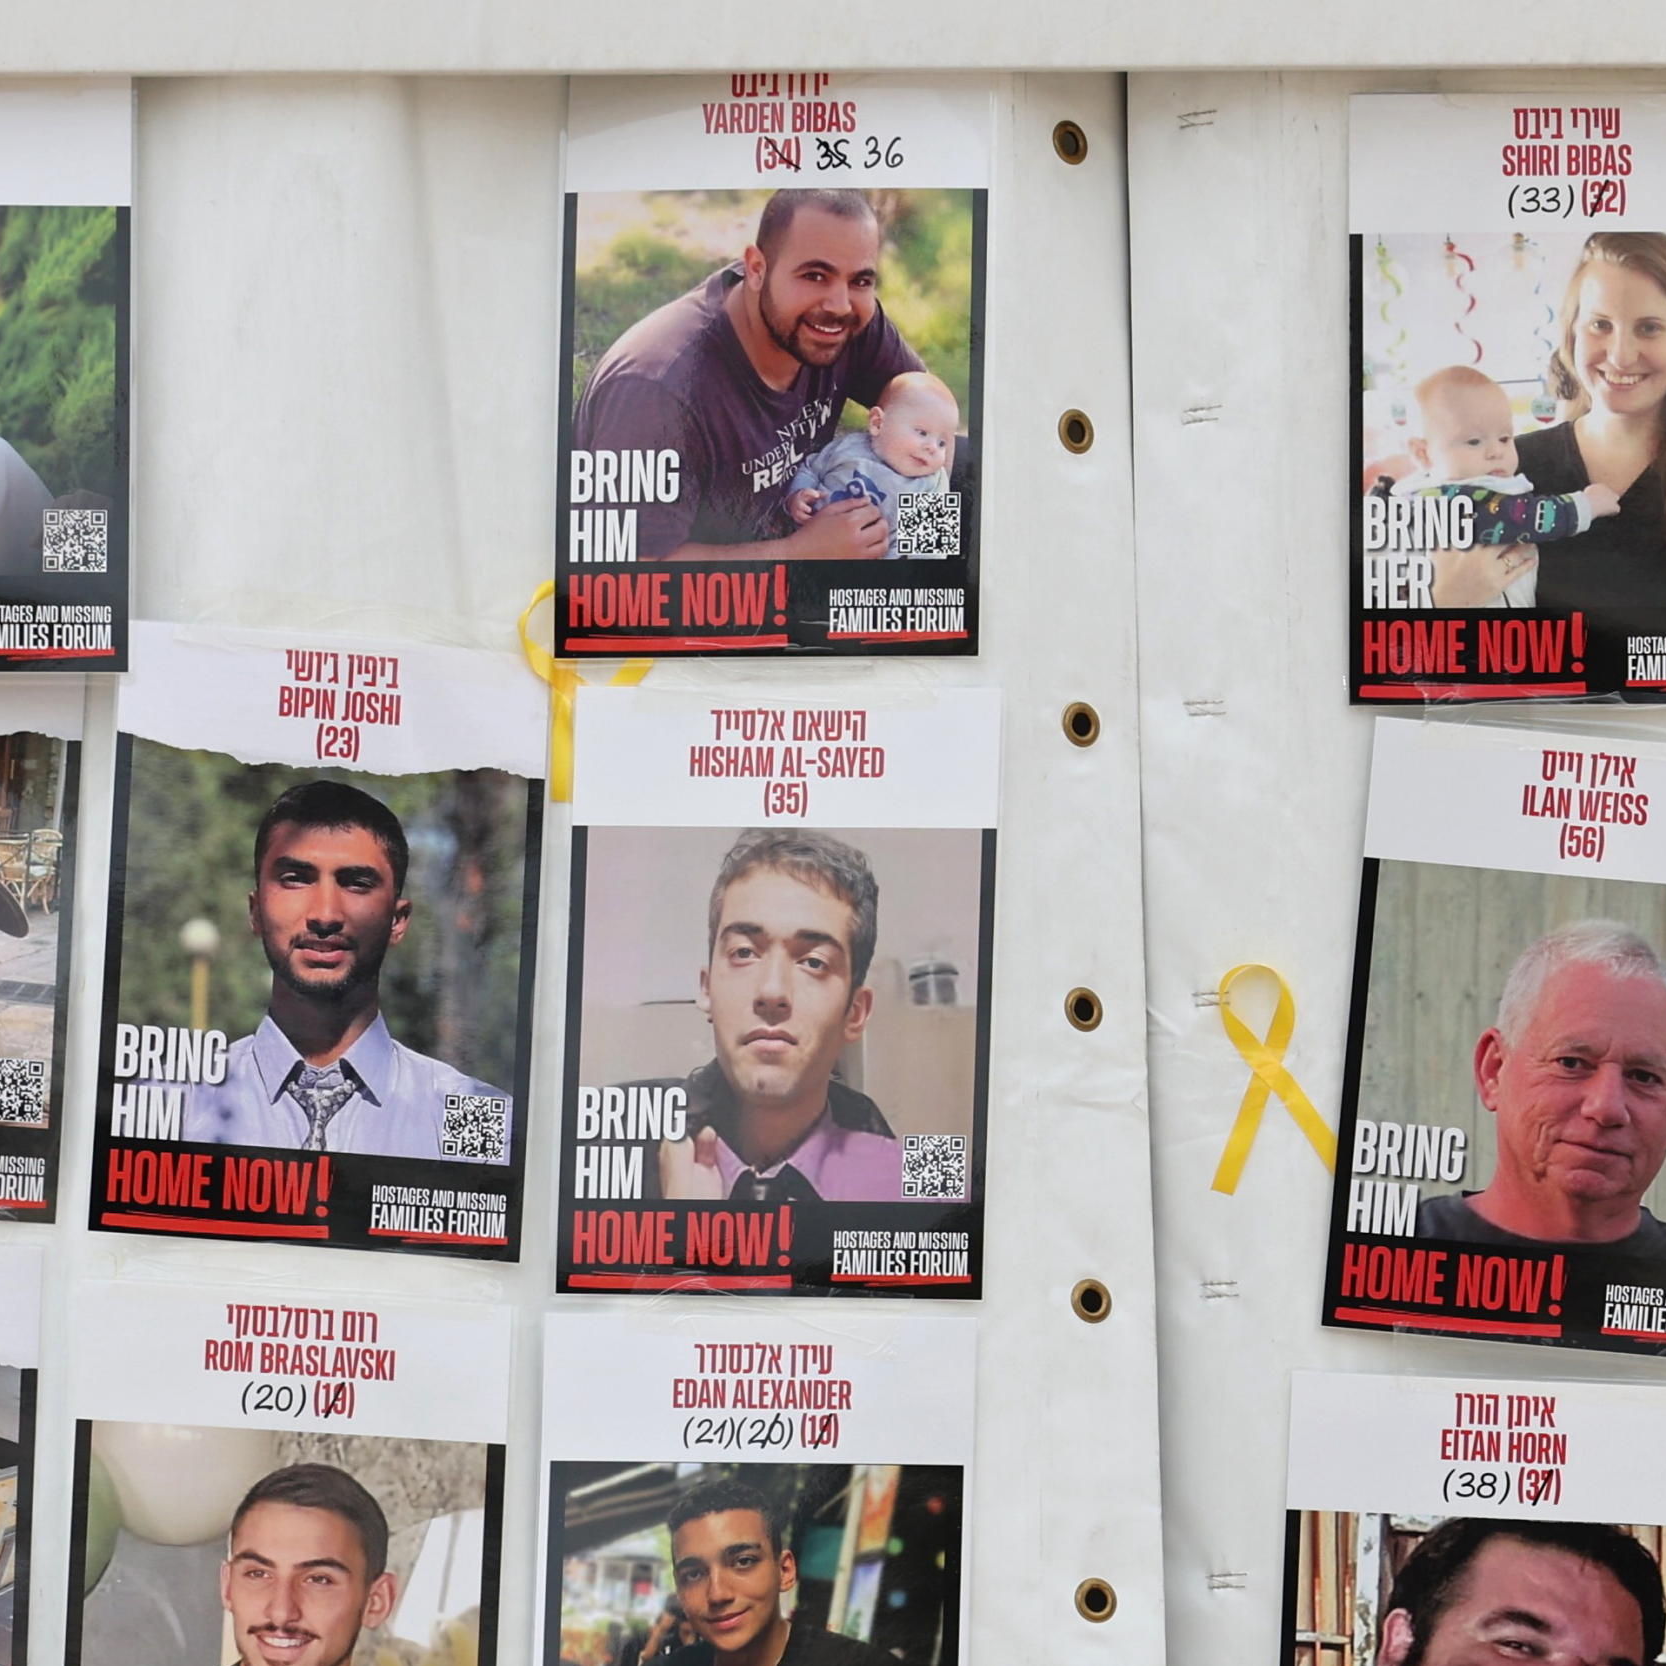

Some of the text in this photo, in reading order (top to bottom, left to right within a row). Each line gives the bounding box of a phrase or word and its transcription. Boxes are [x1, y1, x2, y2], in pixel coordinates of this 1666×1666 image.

[702, 101, 857, 133] YARDEN BIBAS
[864, 136, 903, 169] 36
[1501, 144, 1634, 176] SHIRI BIBAS
[35, 606, 59, 623] AND
[61, 605, 111, 624] MISSING
[53, 624, 111, 650] FORUM
[278, 685, 402, 725] BIPIN JOSHI
[711, 709, 867, 741] הישאם אלסייד
[690, 746, 885, 778] HISHAM AL-SAYED
[1522, 785, 1650, 826] ILAN WEISS
[205, 1339, 396, 1381] ROM BRASLAVSKI
[672, 1379, 853, 1410] EDAN ALEXANDER
[1455, 1392, 1556, 1430] איתן הורן
[1441, 1429, 1568, 1464] EITAN HORN
